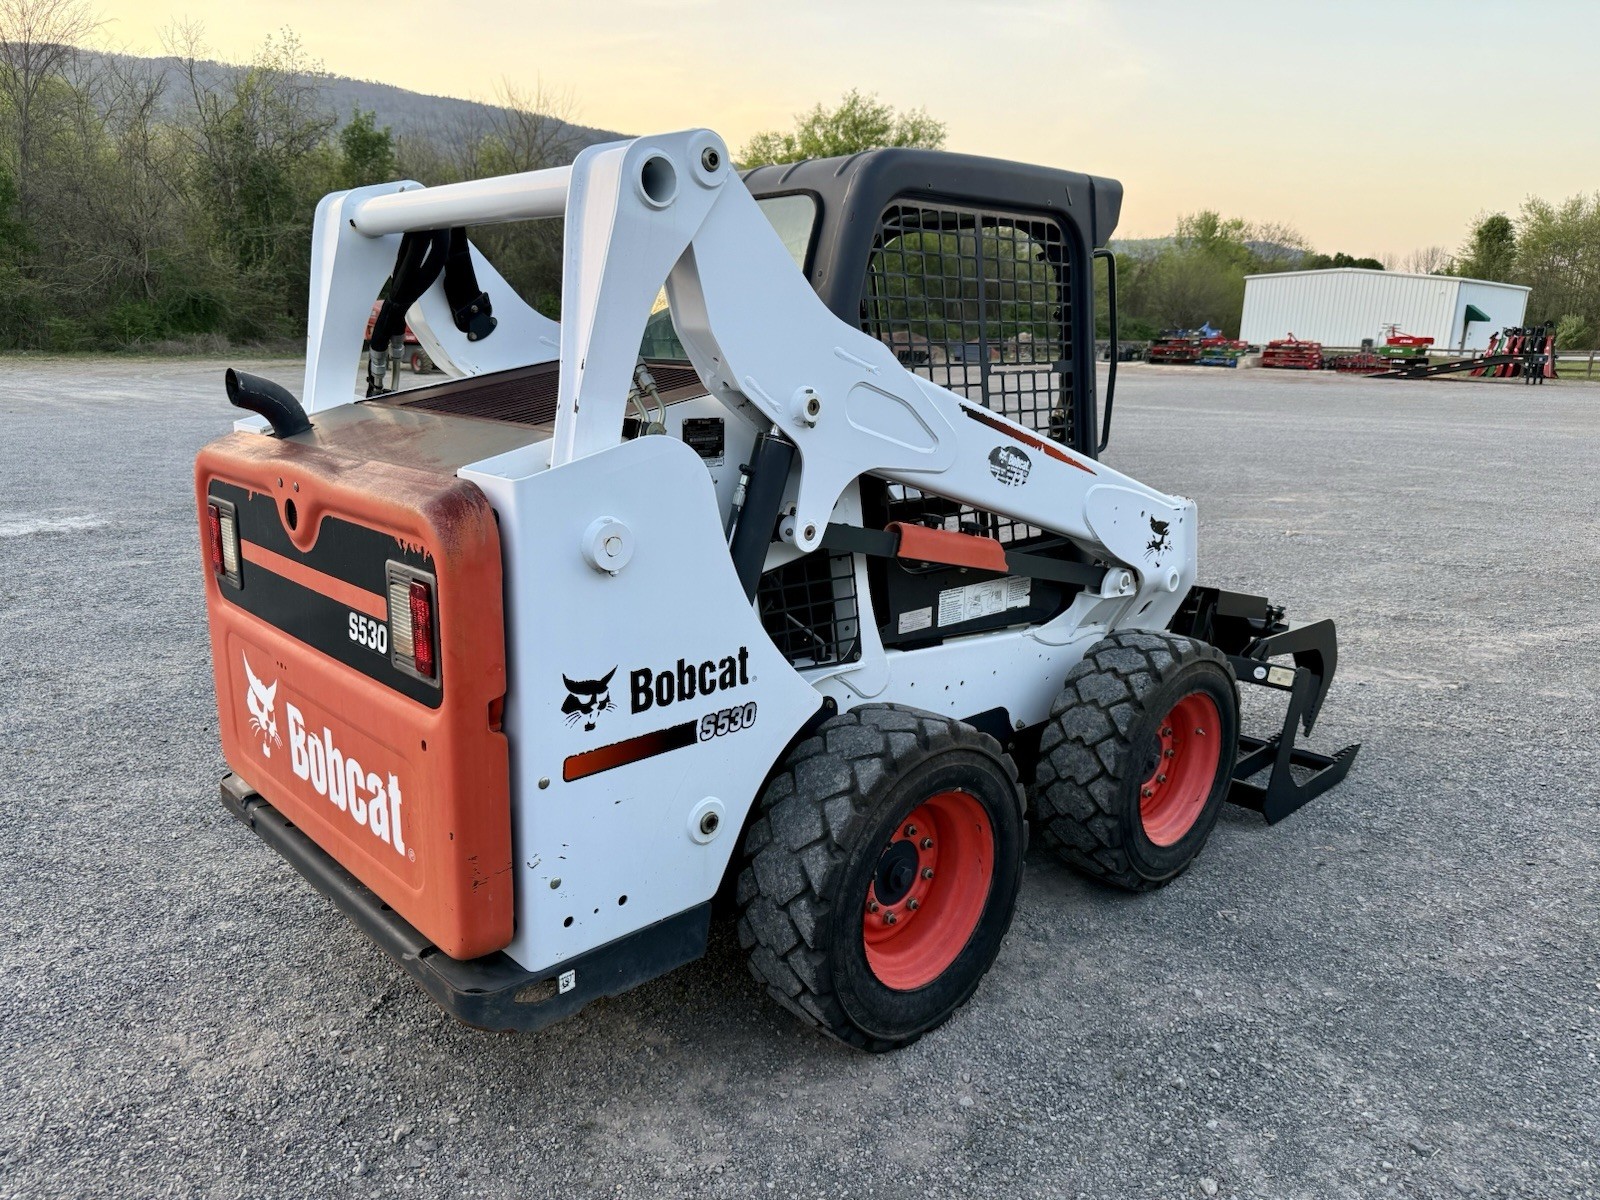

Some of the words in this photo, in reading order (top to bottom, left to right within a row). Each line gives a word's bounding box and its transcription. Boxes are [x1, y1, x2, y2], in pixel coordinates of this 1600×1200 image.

[348, 611, 388, 655] S530
[630, 646, 749, 715] Bobcat
[700, 701, 758, 742] S530
[286, 701, 406, 857] Bobcat
